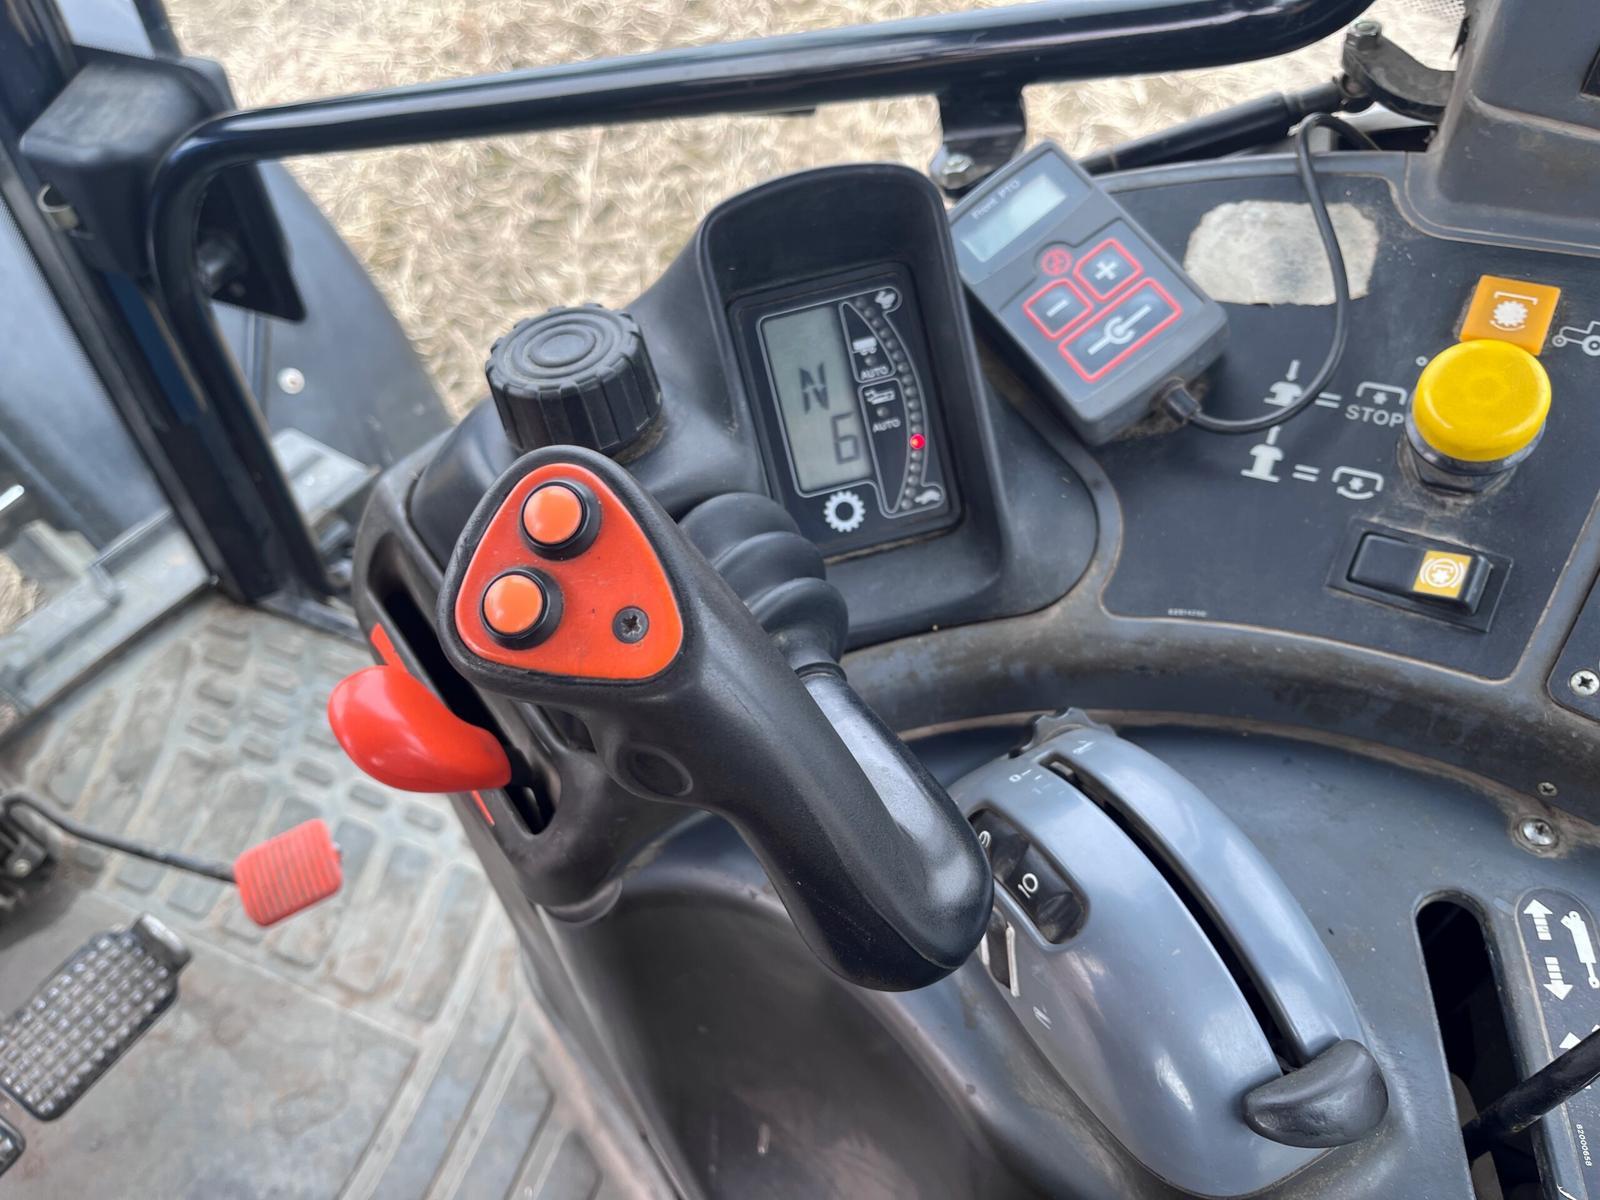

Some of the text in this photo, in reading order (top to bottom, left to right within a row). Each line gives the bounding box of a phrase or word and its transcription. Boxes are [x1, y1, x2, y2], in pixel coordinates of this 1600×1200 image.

[861, 366, 889, 380] AUTO
[799, 362, 829, 415] N
[873, 418, 902, 433] AUTO
[1344, 404, 1405, 428] STOP
[831, 411, 860, 464] 6
[1018, 873, 1039, 898] 10
